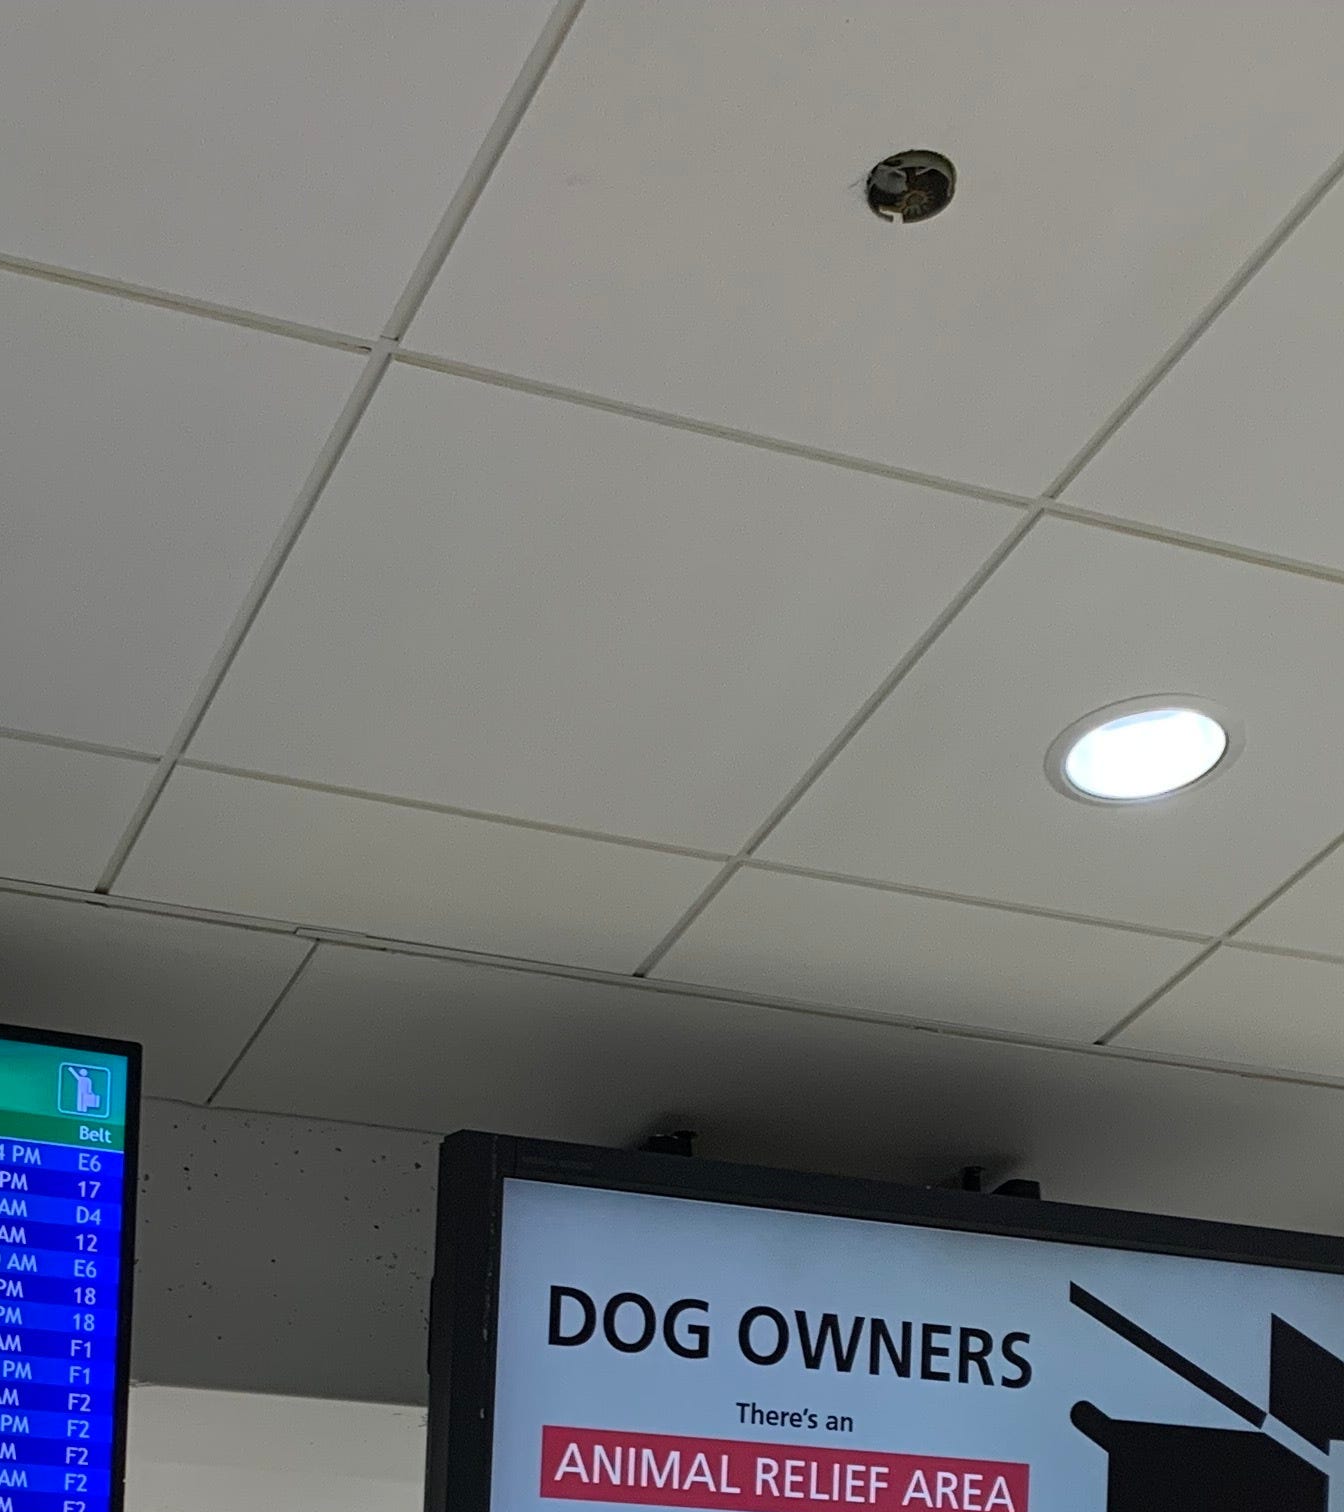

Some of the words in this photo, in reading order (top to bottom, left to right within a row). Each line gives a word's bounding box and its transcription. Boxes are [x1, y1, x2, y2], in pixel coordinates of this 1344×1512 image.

[76, 1206, 101, 1225] D4
[548, 1285, 709, 1359] DOG
[738, 1306, 1032, 1389] OWNERS
[736, 1402, 818, 1429] There's
[826, 1415, 853, 1432] an
[555, 1443, 741, 1493] ANIMAL
[756, 1457, 889, 1503] RELIEF
[902, 1470, 1015, 1512] AREA
